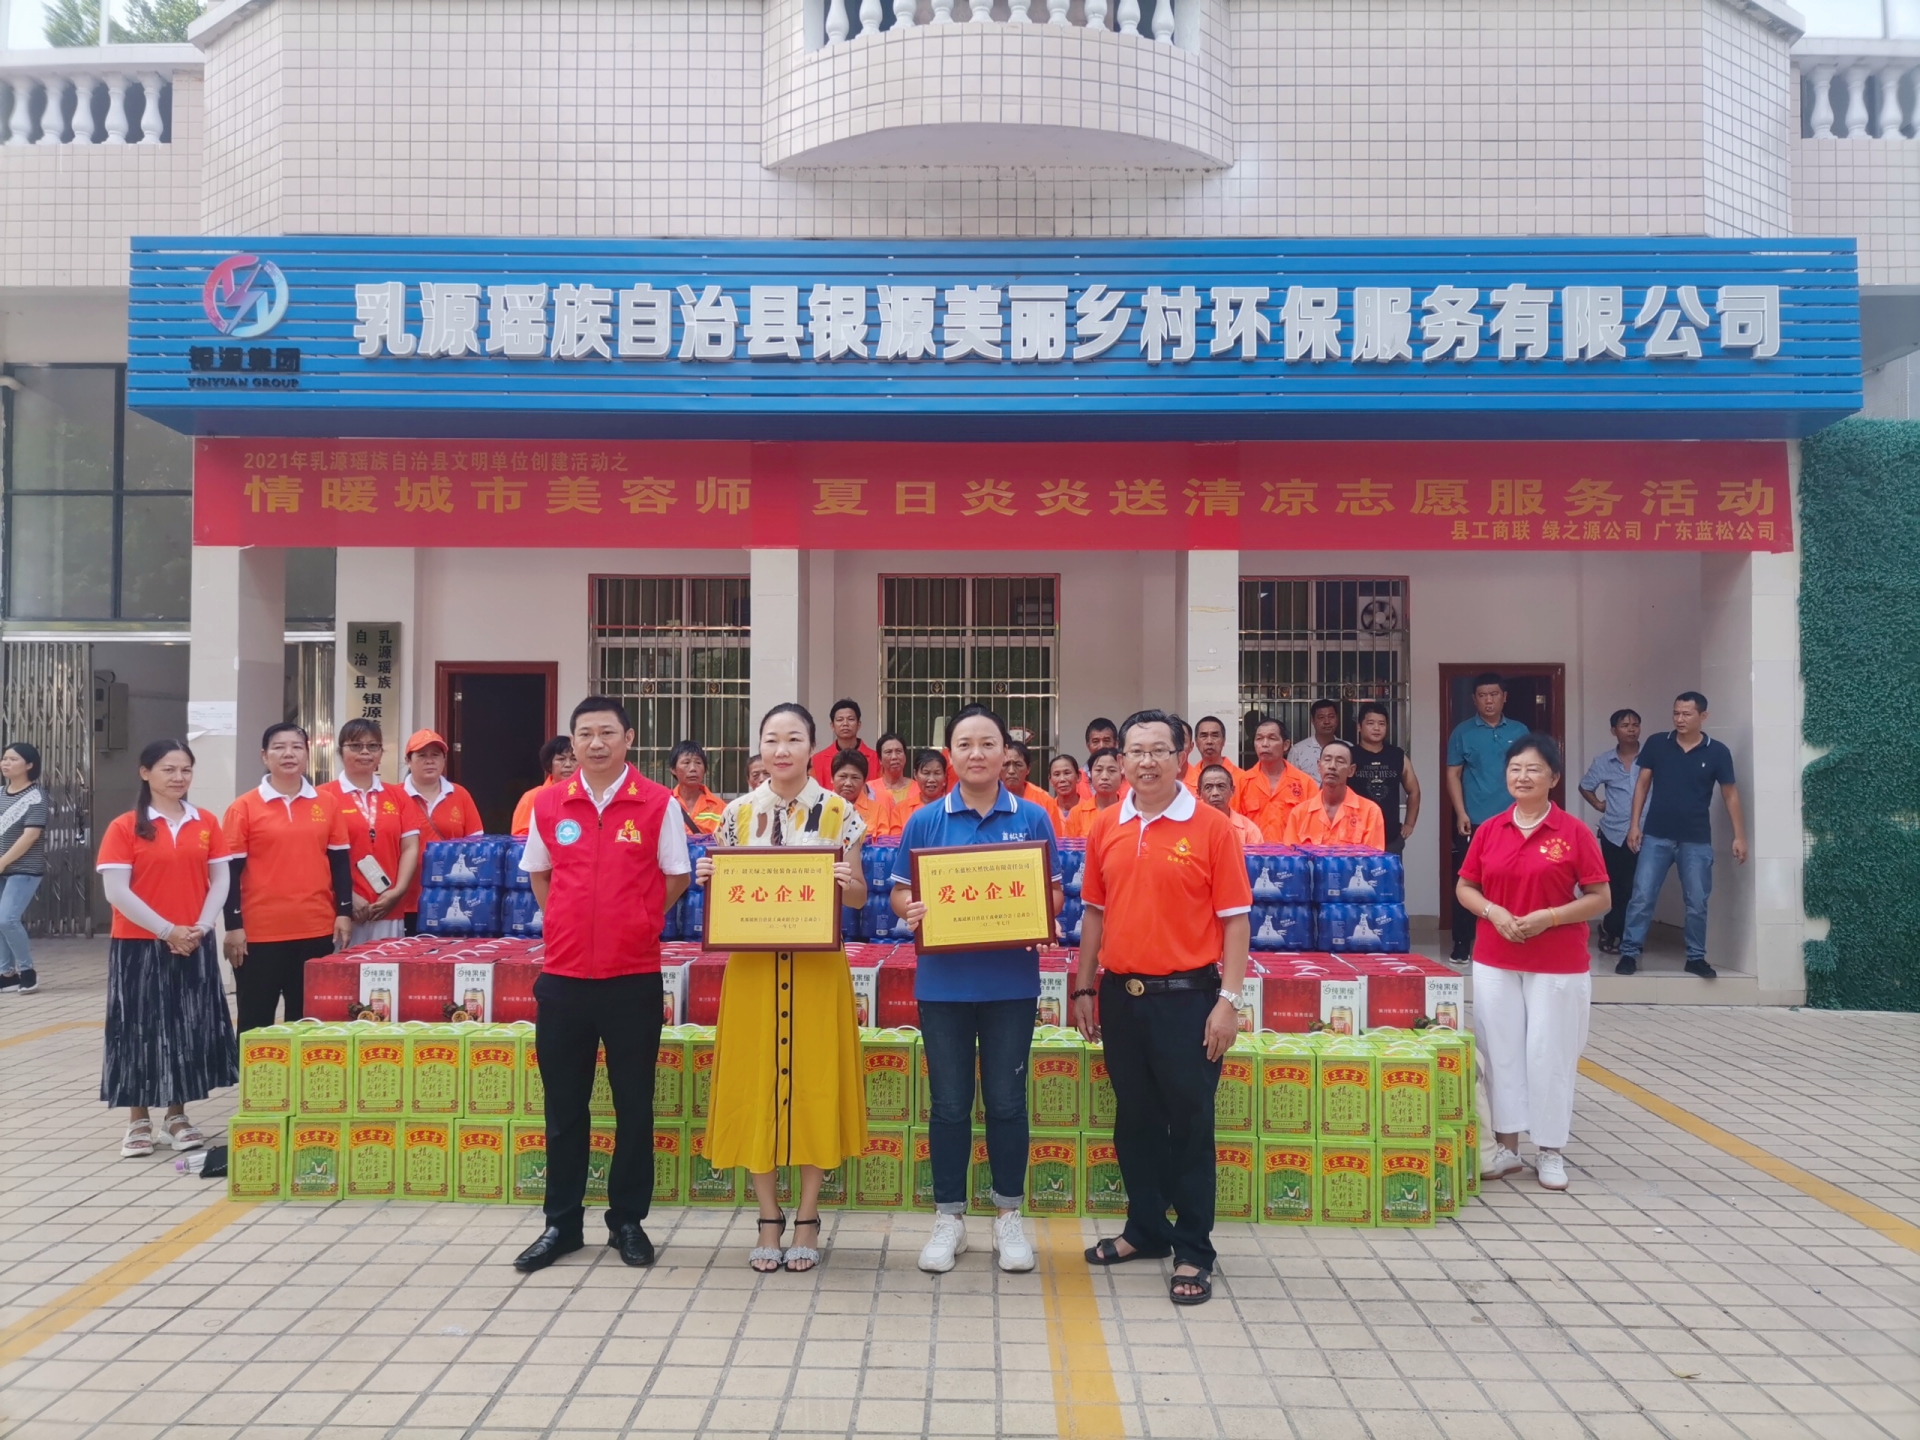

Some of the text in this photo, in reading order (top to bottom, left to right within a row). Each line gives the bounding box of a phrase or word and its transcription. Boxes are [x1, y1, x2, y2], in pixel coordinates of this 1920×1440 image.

[353, 280, 1780, 362] 乳源瑶族自治县银源美丽乡村环保服务有限公司
[187, 377, 300, 389] YINYUAN GROUP
[243, 450, 629, 472] 2021年乳源瑶族自治县文明单位创建活动之
[243, 474, 1774, 517] 情暖城市美容师 夏日炎炎送清凉志愿服务活动
[1450, 520, 1775, 541] 县工商联 绿之源公司 广东蓝松公司
[354, 629, 368, 689] 自治县
[728, 884, 815, 903] 爱心企业
[938, 881, 1026, 904] 爱心企业
[253, 1049, 282, 1059] 王老吉
[310, 1050, 339, 1060] 王老吉
[368, 1049, 397, 1060] 王老吉
[422, 1048, 452, 1060] 王老吉
[478, 1050, 507, 1062] 王老吉
[873, 1056, 901, 1066] 王老吉
[1042, 1062, 1071, 1073] 王老吉
[1274, 1068, 1302, 1080] 王老吉
[1332, 1070, 1359, 1081] 王老吉
[1391, 1072, 1420, 1083] 王老吉
[242, 1133, 273, 1143] 王老吉
[302, 1131, 332, 1142] 王老吉
[358, 1130, 388, 1141] 王老吉
[413, 1132, 440, 1142] 王老吉
[467, 1135, 495, 1146] 王老吉
[1038, 1147, 1067, 1158] 王老吉
[1274, 1156, 1304, 1166] 王老吉
[1333, 1157, 1361, 1168] 王老吉
[1391, 1158, 1420, 1168] 王老吉
